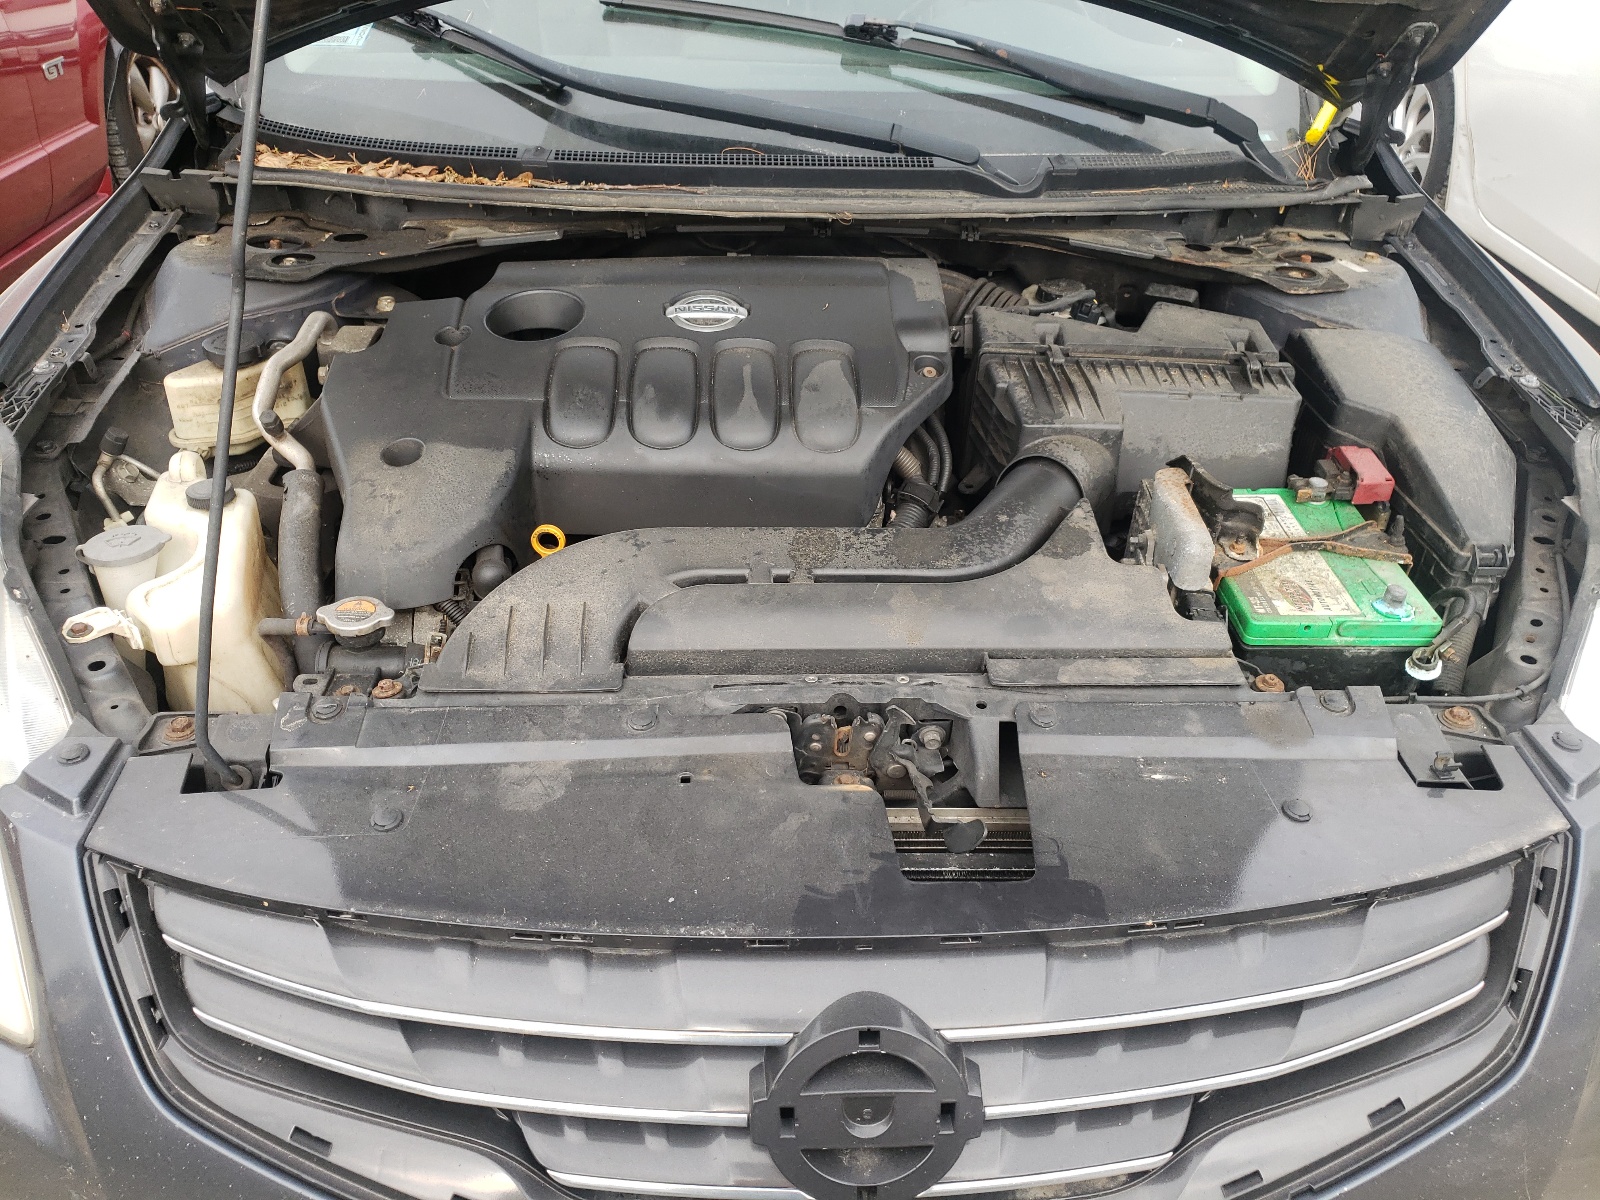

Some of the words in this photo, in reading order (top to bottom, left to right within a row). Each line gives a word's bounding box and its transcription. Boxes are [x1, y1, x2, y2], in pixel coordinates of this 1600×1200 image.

[42, 56, 64, 80] GT
[674, 304, 739, 314] NISSAN
[1304, 579, 1332, 612] AUTOMOTIVE
